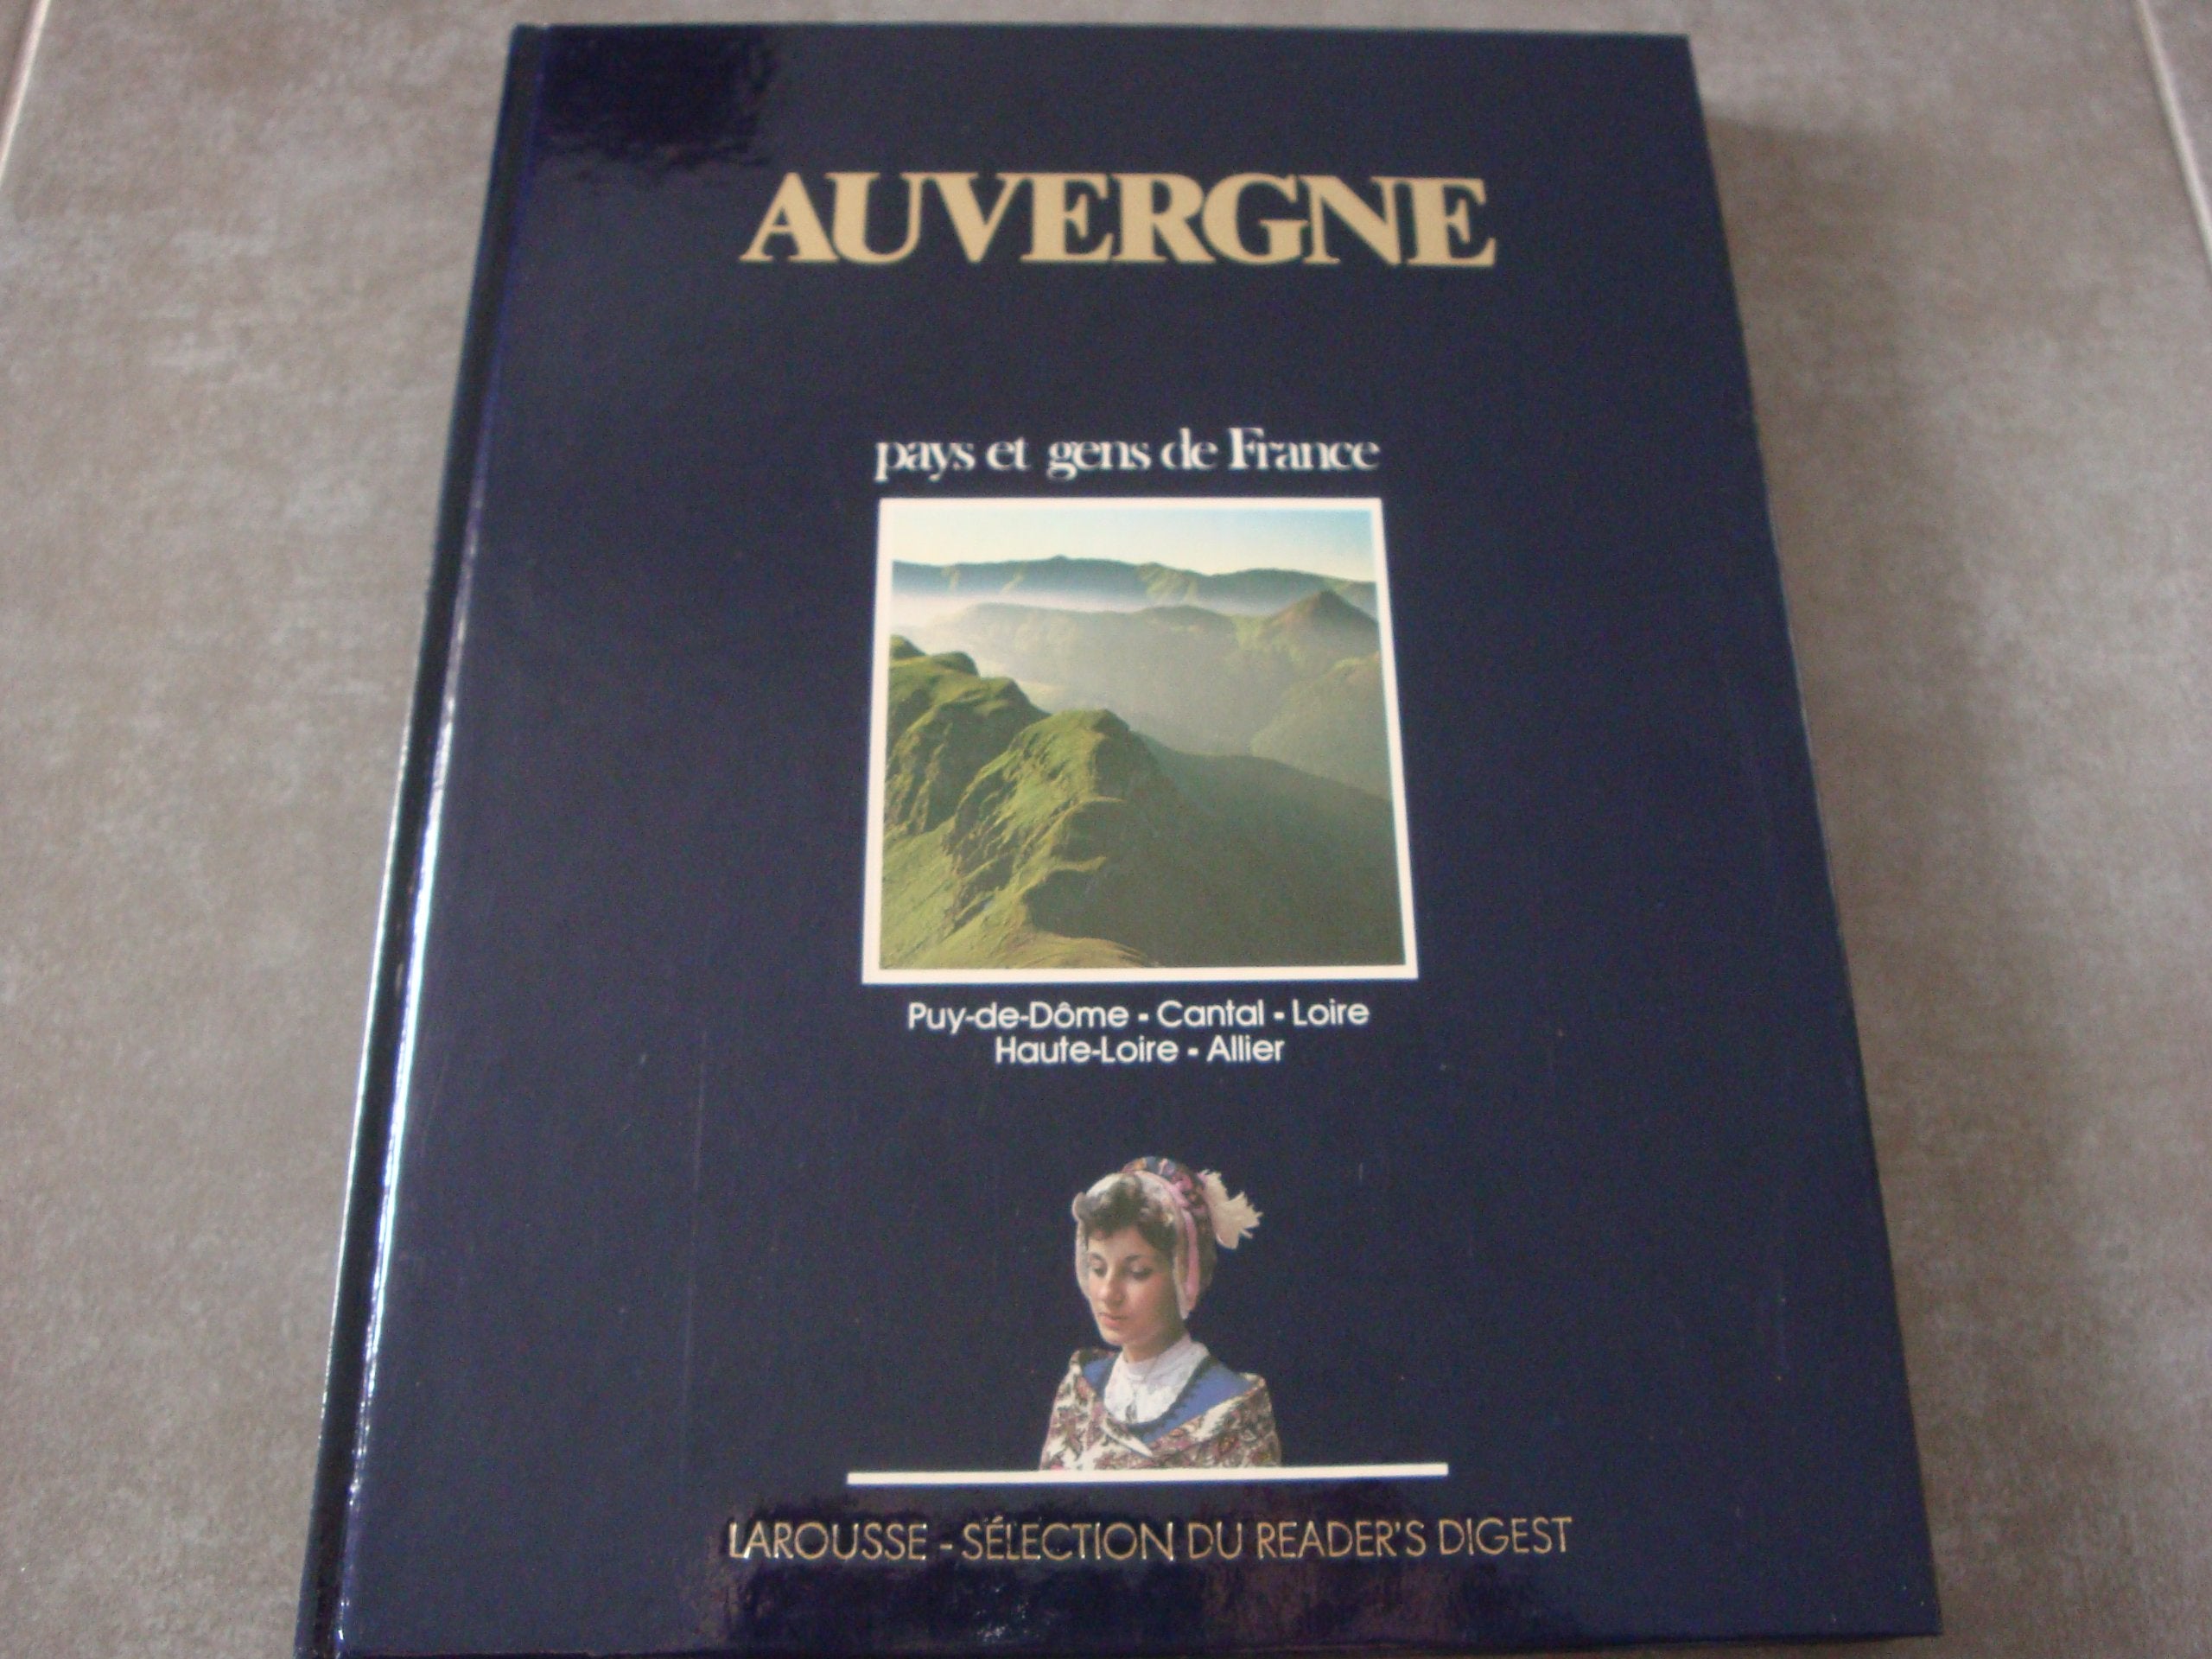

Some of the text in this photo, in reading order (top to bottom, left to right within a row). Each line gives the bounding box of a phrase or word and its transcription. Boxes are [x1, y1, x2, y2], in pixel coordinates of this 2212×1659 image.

[739, 171, 1496, 268] AUVERGNE
[874, 426, 1381, 483] pays et gens de France
[906, 1000, 1130, 1036] Puy-de-Dôme
[1155, 999, 1266, 1029] Cantal
[1291, 998, 1371, 1027] Loire
[994, 1033, 1180, 1065] Haute-Loire
[1205, 1033, 1286, 1063] Allier
[728, 1521, 928, 1562] LAROUSSE
[961, 1515, 1175, 1562] SÉLECTION
[1187, 1521, 1243, 1560] DU
[1256, 1519, 1427, 1559] READER'S
[1438, 1516, 1573, 1556] DIGEST
